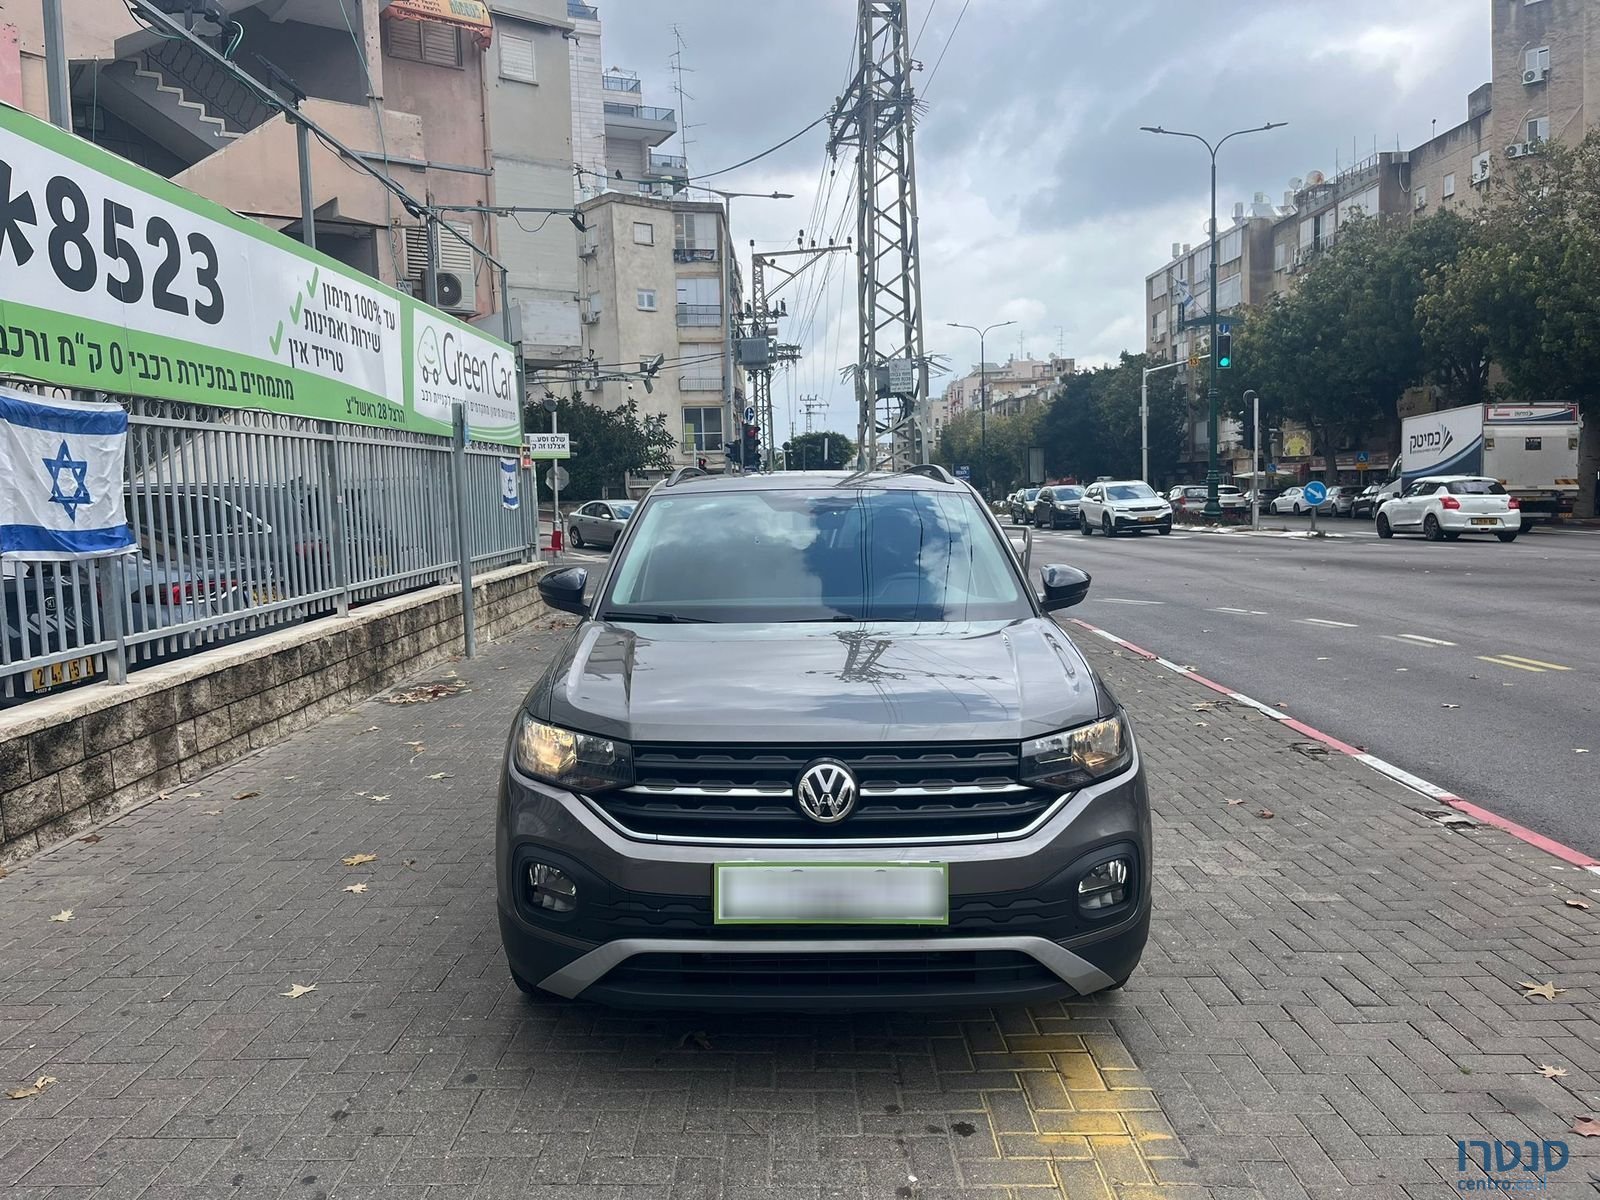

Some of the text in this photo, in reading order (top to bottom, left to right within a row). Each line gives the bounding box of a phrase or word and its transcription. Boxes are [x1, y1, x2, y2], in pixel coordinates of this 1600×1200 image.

[322, 282, 396, 331] עד 100% מימון
[304, 308, 381, 353] שירות ואמינות
[110, 341, 123, 375] 0
[128, 351, 173, 382] רכבי
[288, 337, 344, 373] טרייד אין
[442, 332, 512, 401] Green Car
[176, 359, 237, 390] במכירת
[240, 371, 295, 401] מתמחים
[377, 402, 388, 420] 28
[421, 389, 432, 402] רכב
[388, 404, 405, 424] הרצל
[550, 435, 566, 443] שלם
[1409, 431, 1441, 455] כמיטק
